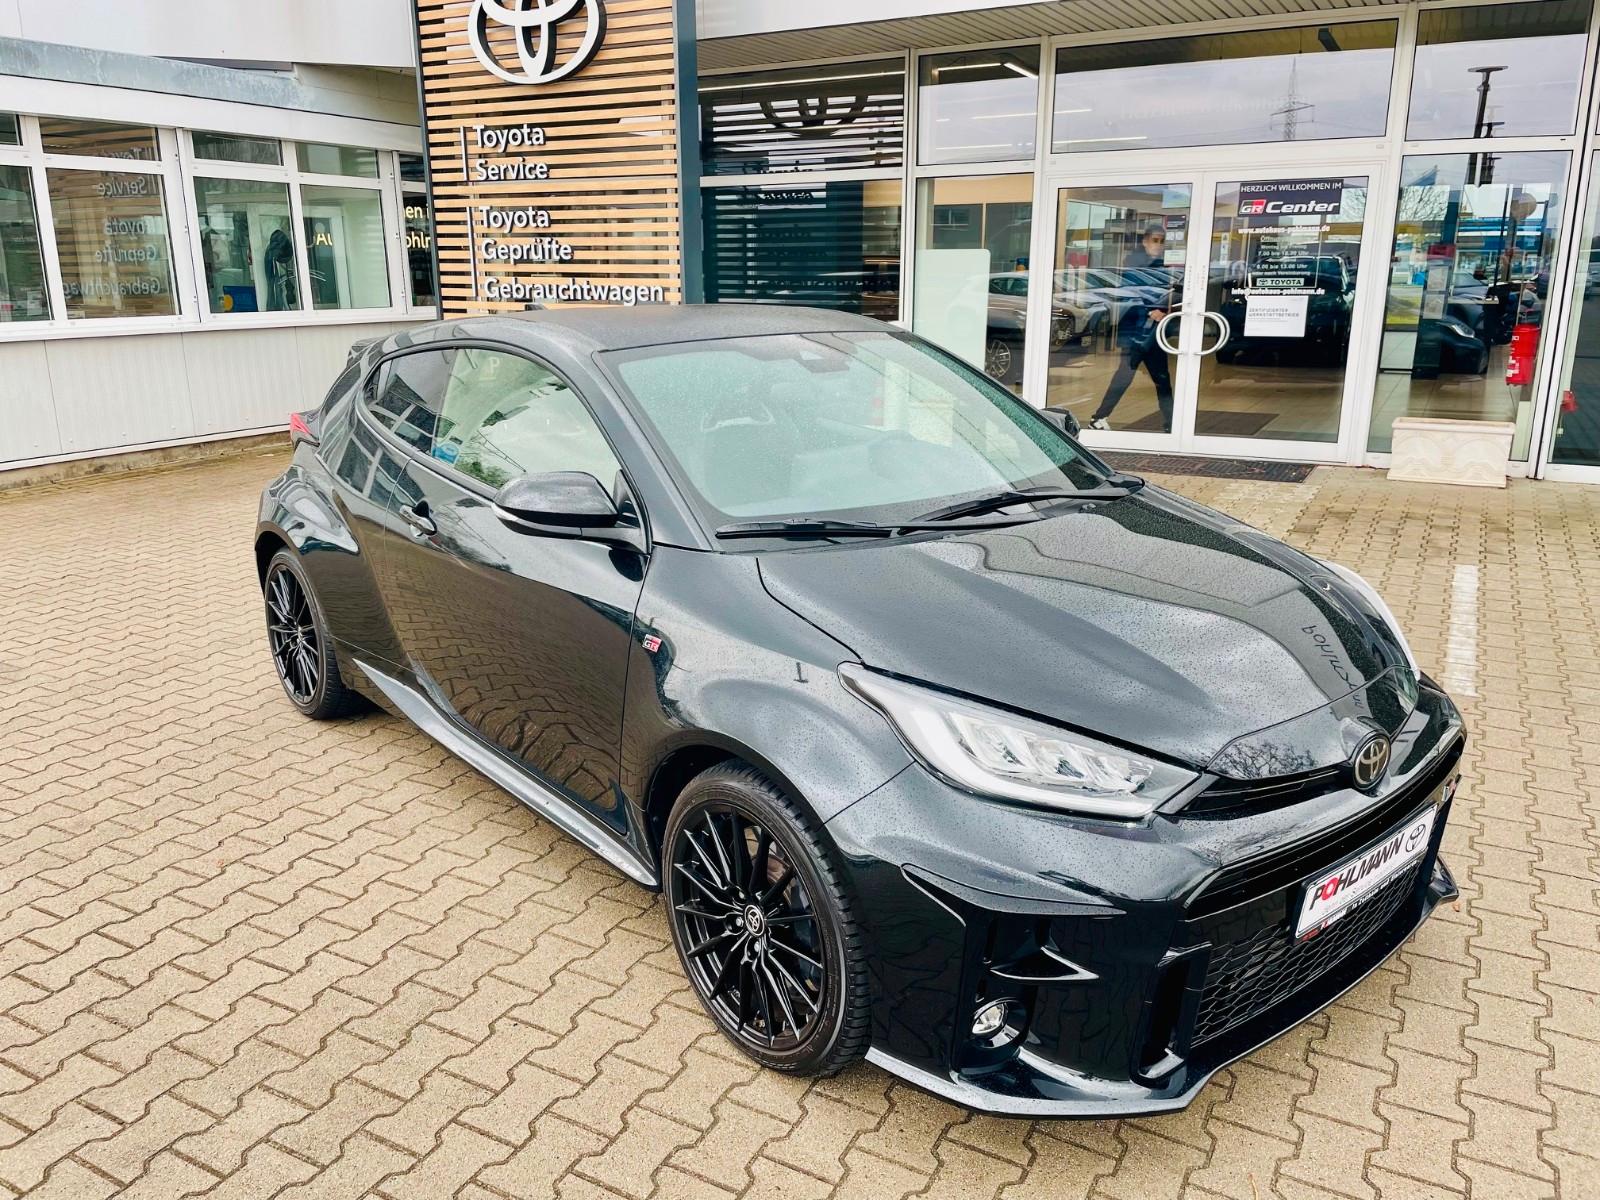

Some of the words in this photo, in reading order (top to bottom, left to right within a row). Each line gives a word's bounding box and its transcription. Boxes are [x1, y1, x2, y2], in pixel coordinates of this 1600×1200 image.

[473, 124, 546, 152] Toyota
[475, 158, 549, 180] Service
[1241, 185, 1277, 193] HERZLICH
[1278, 183, 1331, 191] WILLKOMMEN
[1239, 202, 1265, 214] GR
[1266, 200, 1340, 213] Center
[479, 207, 550, 232] Toyota
[481, 239, 573, 263] Geprüfte
[484, 278, 664, 305] Gebrauchtwagen
[1309, 832, 1406, 911] POHLMANN
